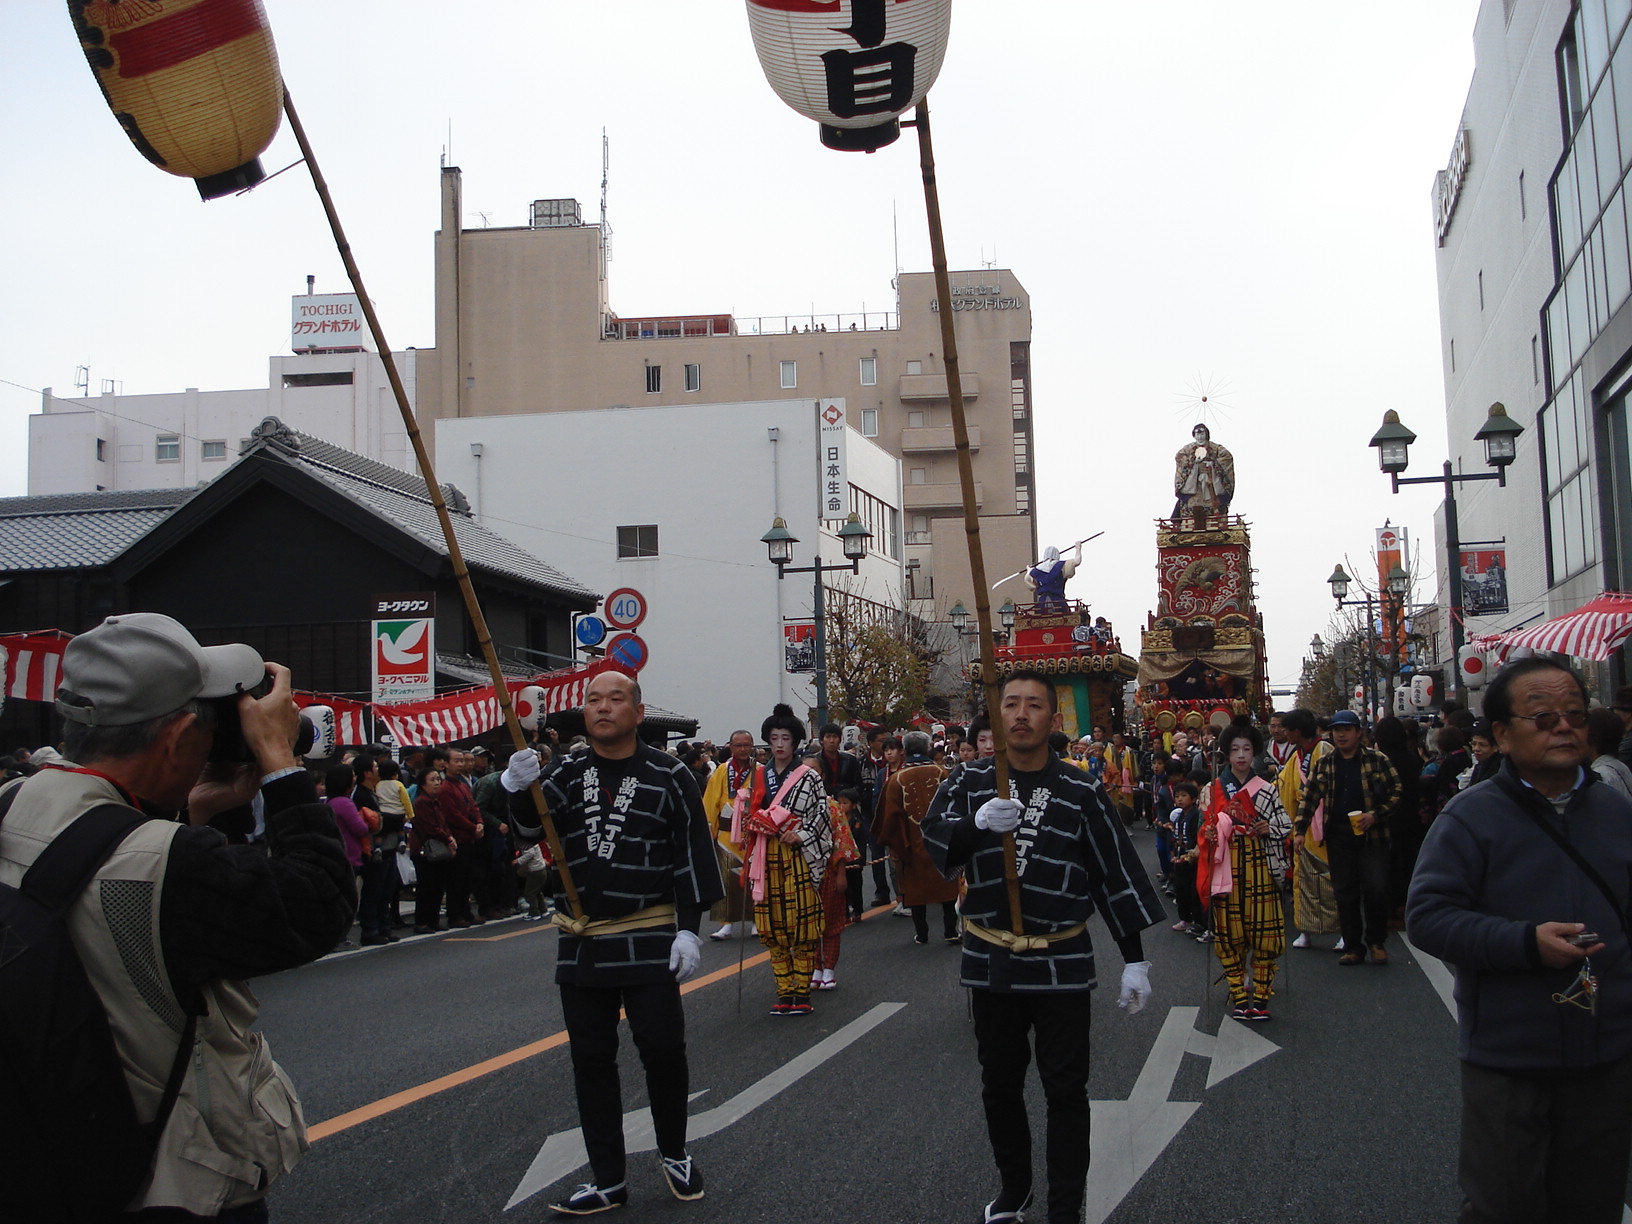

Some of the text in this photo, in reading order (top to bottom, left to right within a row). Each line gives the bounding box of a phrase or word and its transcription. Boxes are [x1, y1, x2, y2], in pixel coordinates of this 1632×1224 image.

[300, 303, 353, 317] TOCHIGI
[930, 297, 1022, 312] グランドホテル
[293, 319, 361, 335] グランドホテル
[826, 446, 841, 512] 日本生命
[377, 600, 429, 612] ヨークタウン
[614, 599, 637, 618] 40
[377, 675, 430, 685] ヨークベニマル
[583, 766, 602, 852] 萬町一丁目
[597, 776, 640, 860] 萬町一丁目
